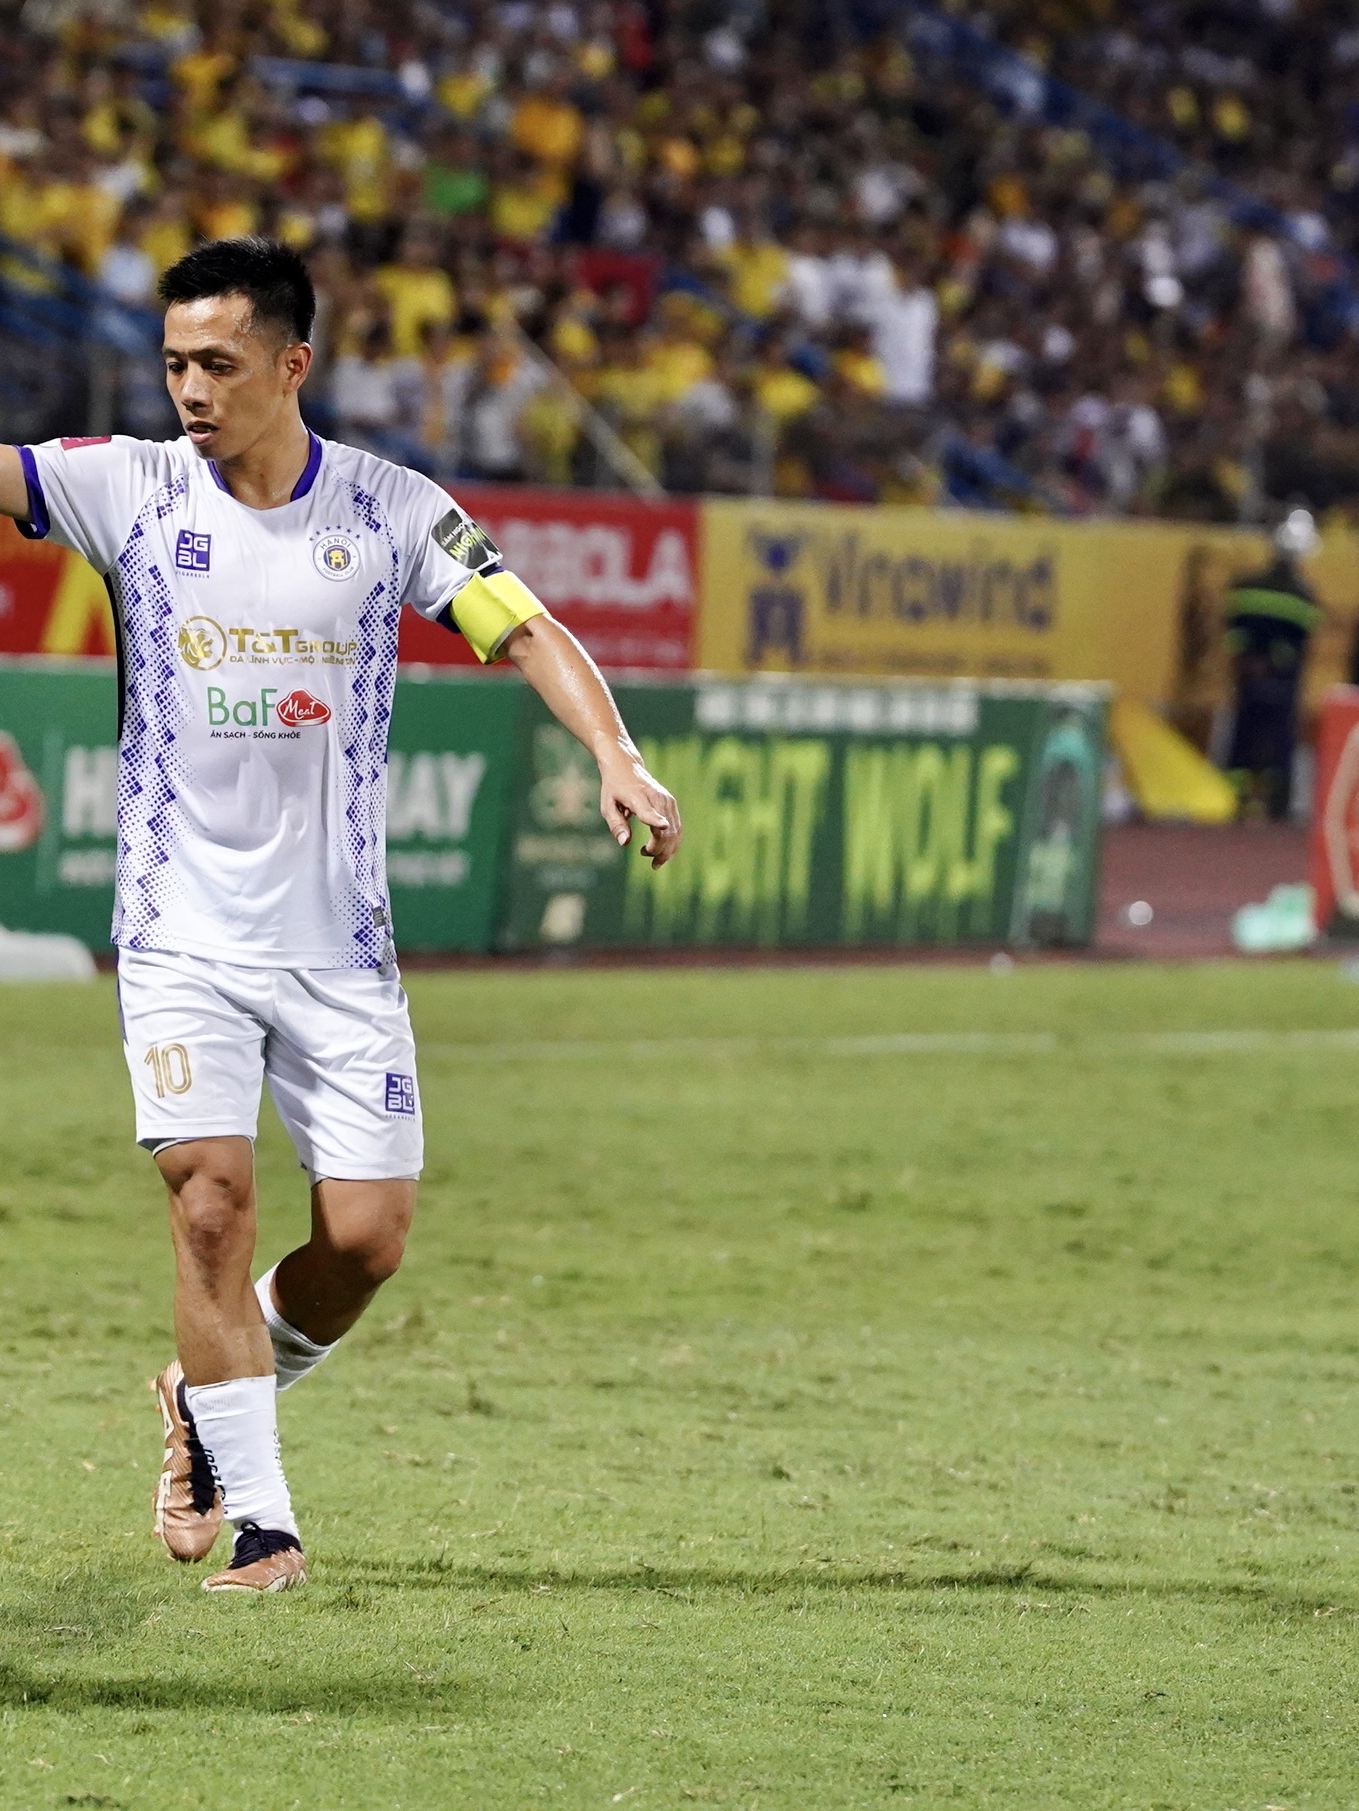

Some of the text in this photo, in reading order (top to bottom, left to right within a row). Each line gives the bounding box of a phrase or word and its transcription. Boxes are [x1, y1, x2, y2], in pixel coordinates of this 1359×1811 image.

[320, 537, 351, 550] HANOI
[207, 686, 316, 727] BaF Meat
[210, 731, 222, 739] ĂN
[223, 731, 246, 741] SẠCH
[253, 730, 276, 740] SỐNG
[143, 1042, 193, 1099] 10
